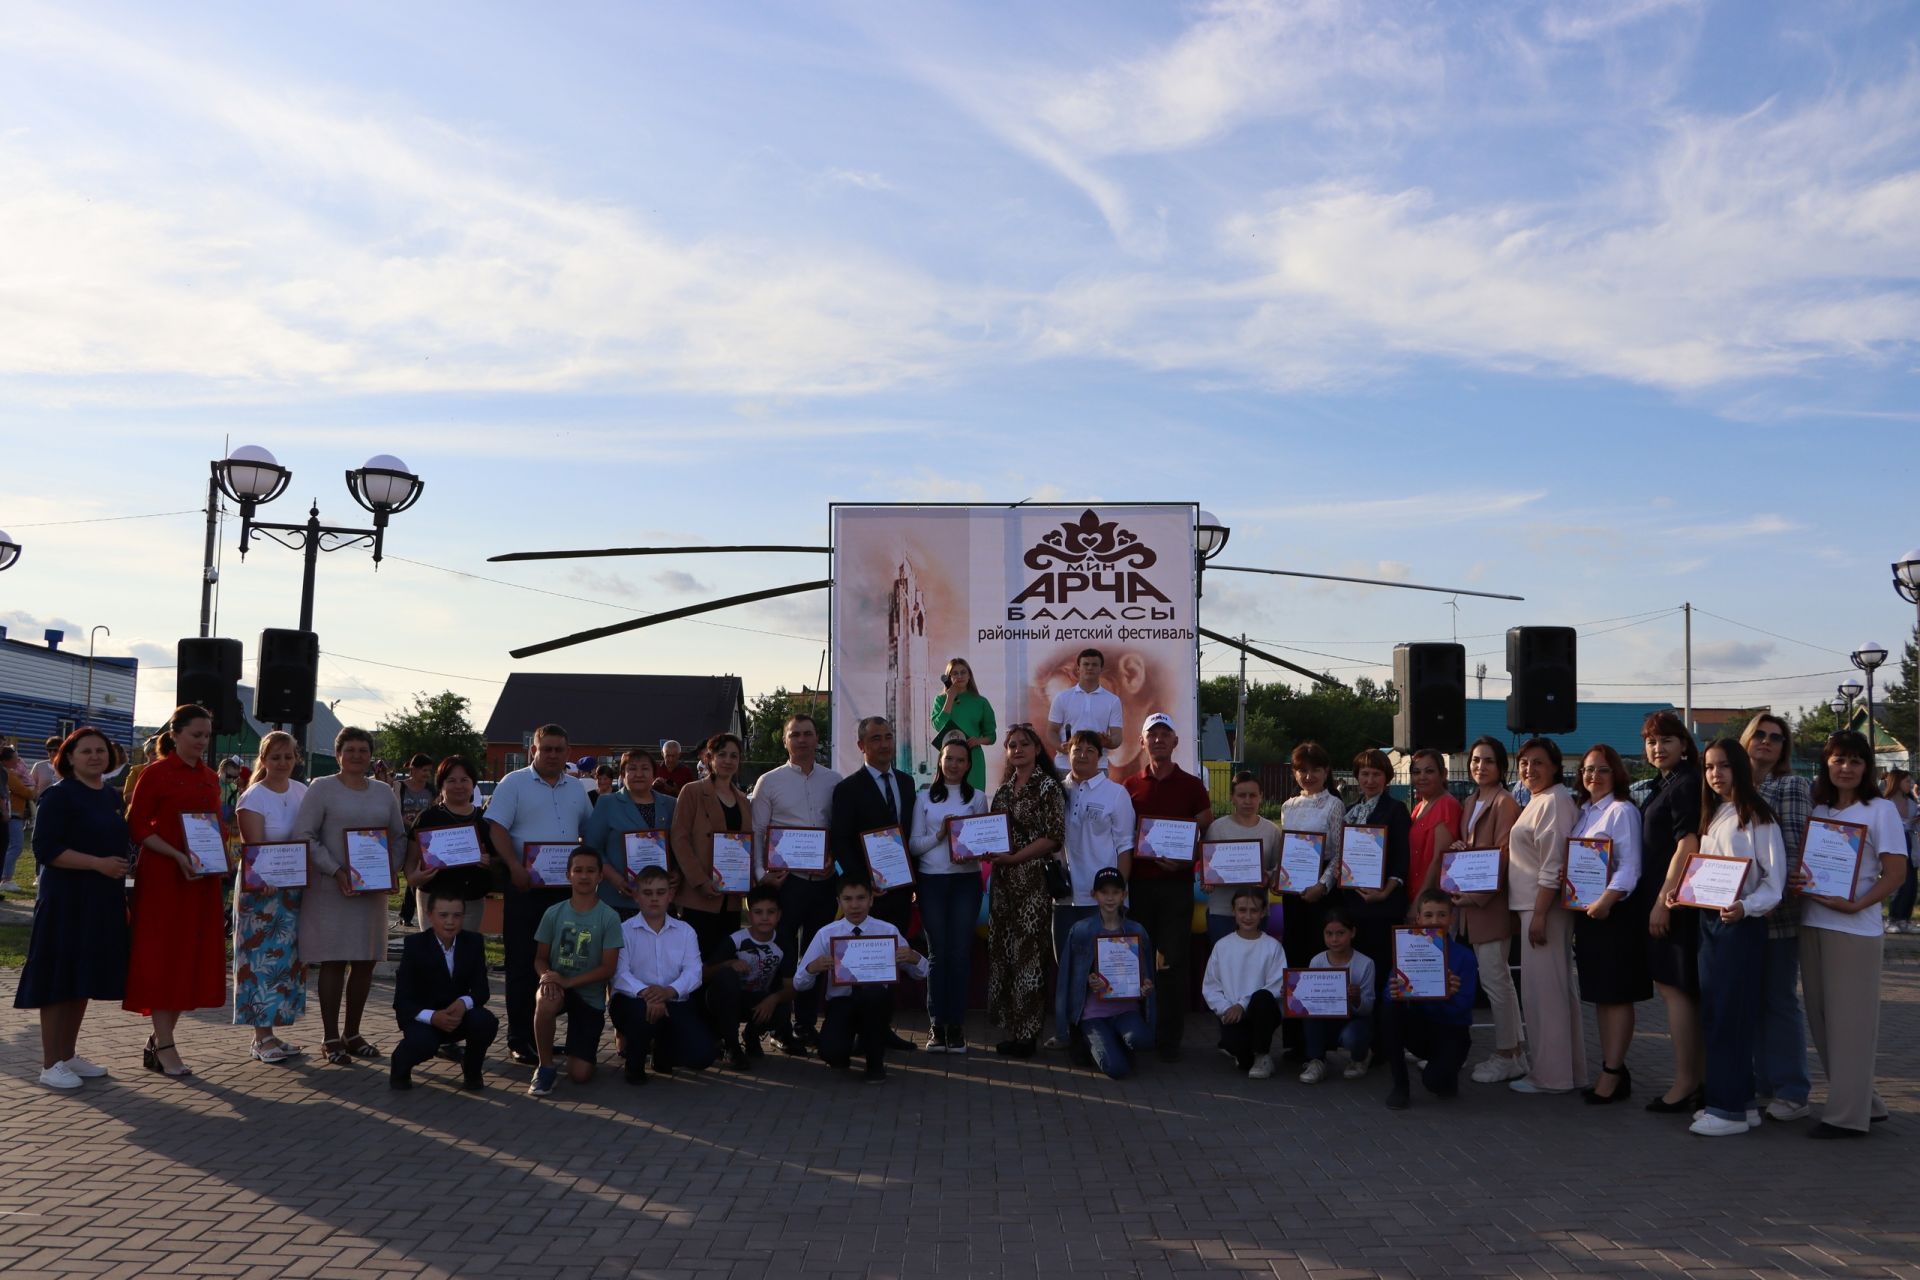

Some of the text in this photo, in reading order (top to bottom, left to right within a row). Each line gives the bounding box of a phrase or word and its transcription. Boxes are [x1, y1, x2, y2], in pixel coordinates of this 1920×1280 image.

[1066, 562, 1116, 572] МИН
[1010, 571, 1173, 604] АРЧА
[1007, 606, 1175, 621] БАЛАСЫ
[978, 624, 1194, 643] районный детский фестиваль
